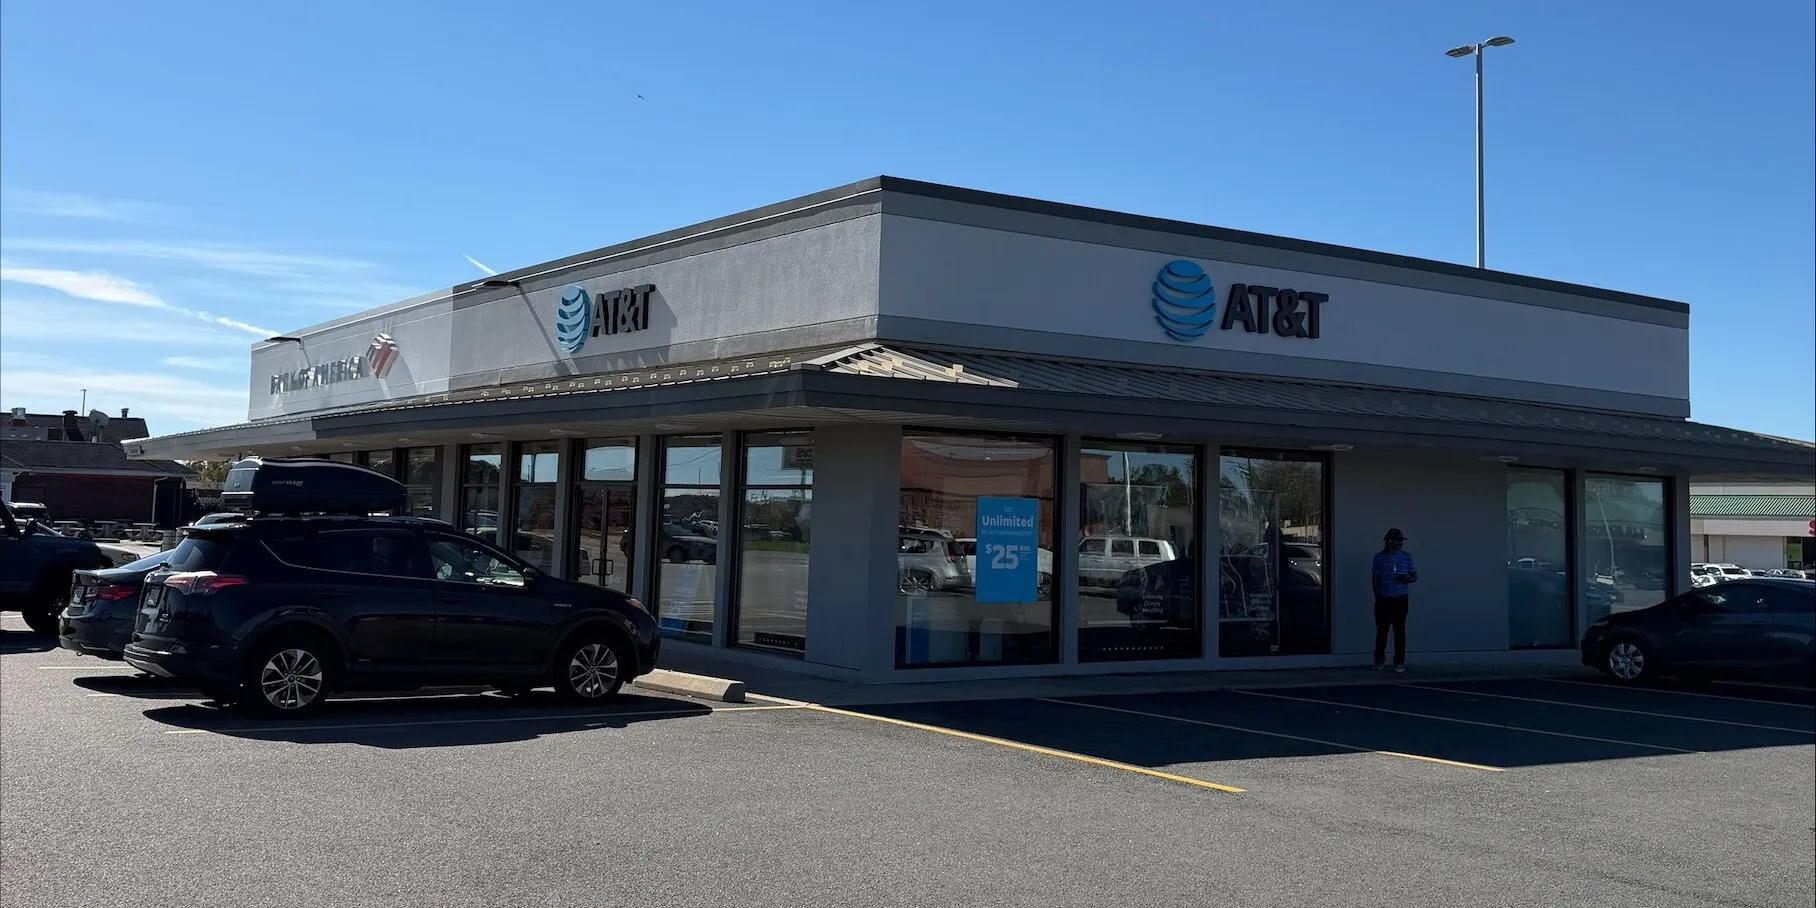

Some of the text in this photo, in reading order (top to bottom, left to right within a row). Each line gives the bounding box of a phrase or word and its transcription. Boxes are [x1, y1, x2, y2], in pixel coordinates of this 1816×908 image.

[590, 284, 655, 342] AT&T
[1220, 283, 1329, 339] AT&T
[982, 515, 1034, 527] Unlimited
[985, 543, 1019, 569] $25
